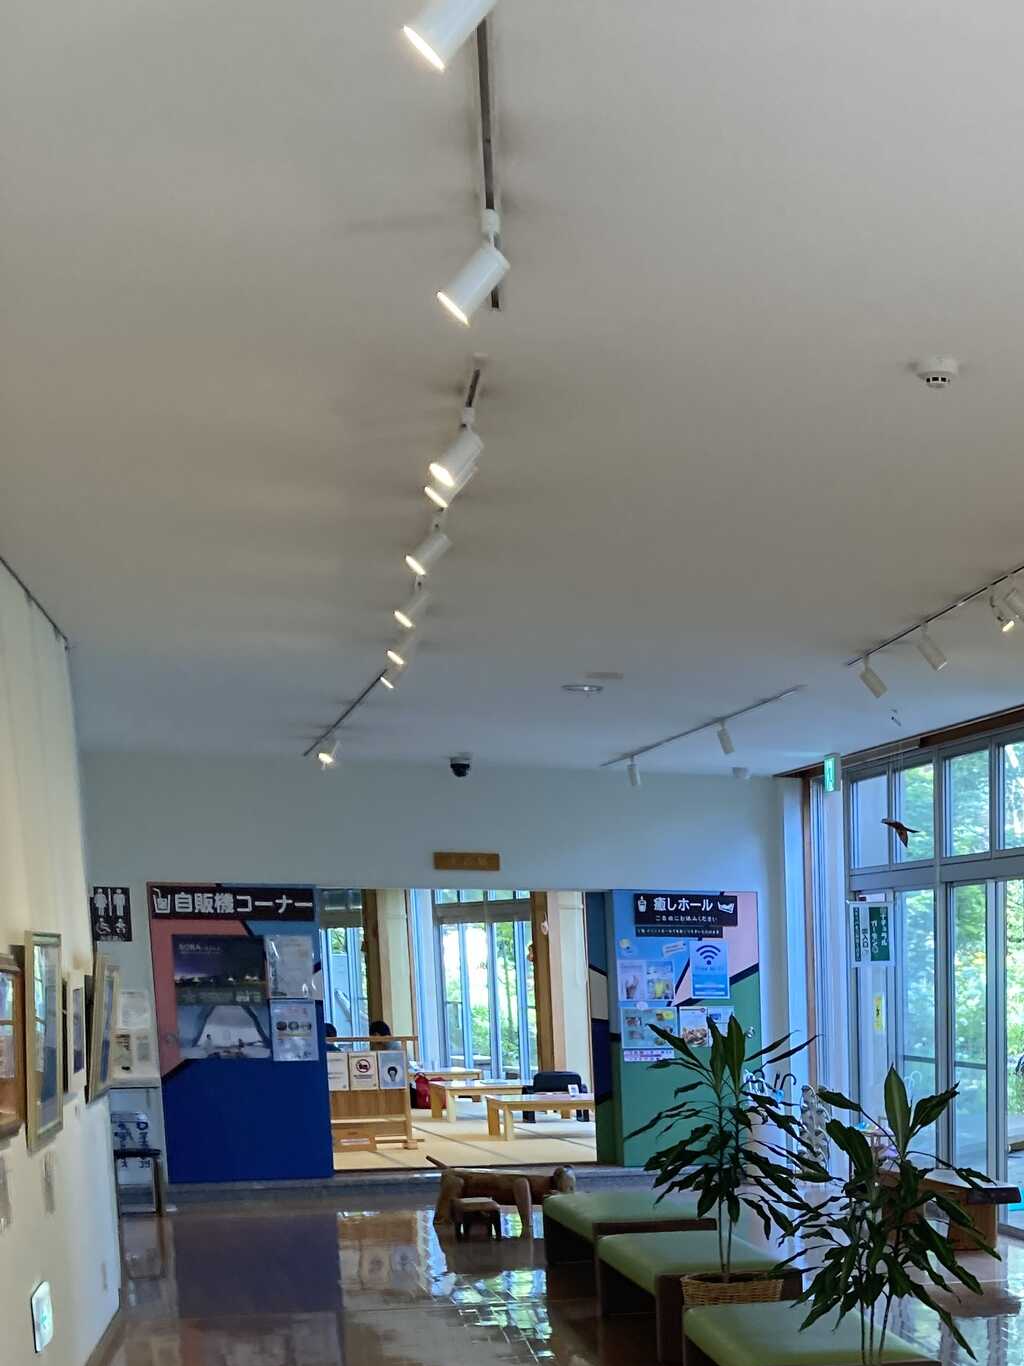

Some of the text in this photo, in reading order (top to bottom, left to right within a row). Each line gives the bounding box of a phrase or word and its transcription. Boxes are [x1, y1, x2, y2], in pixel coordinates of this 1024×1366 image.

[174, 891, 313, 914] 自販機コーナー
[654, 897, 713, 911] 癒しホール
